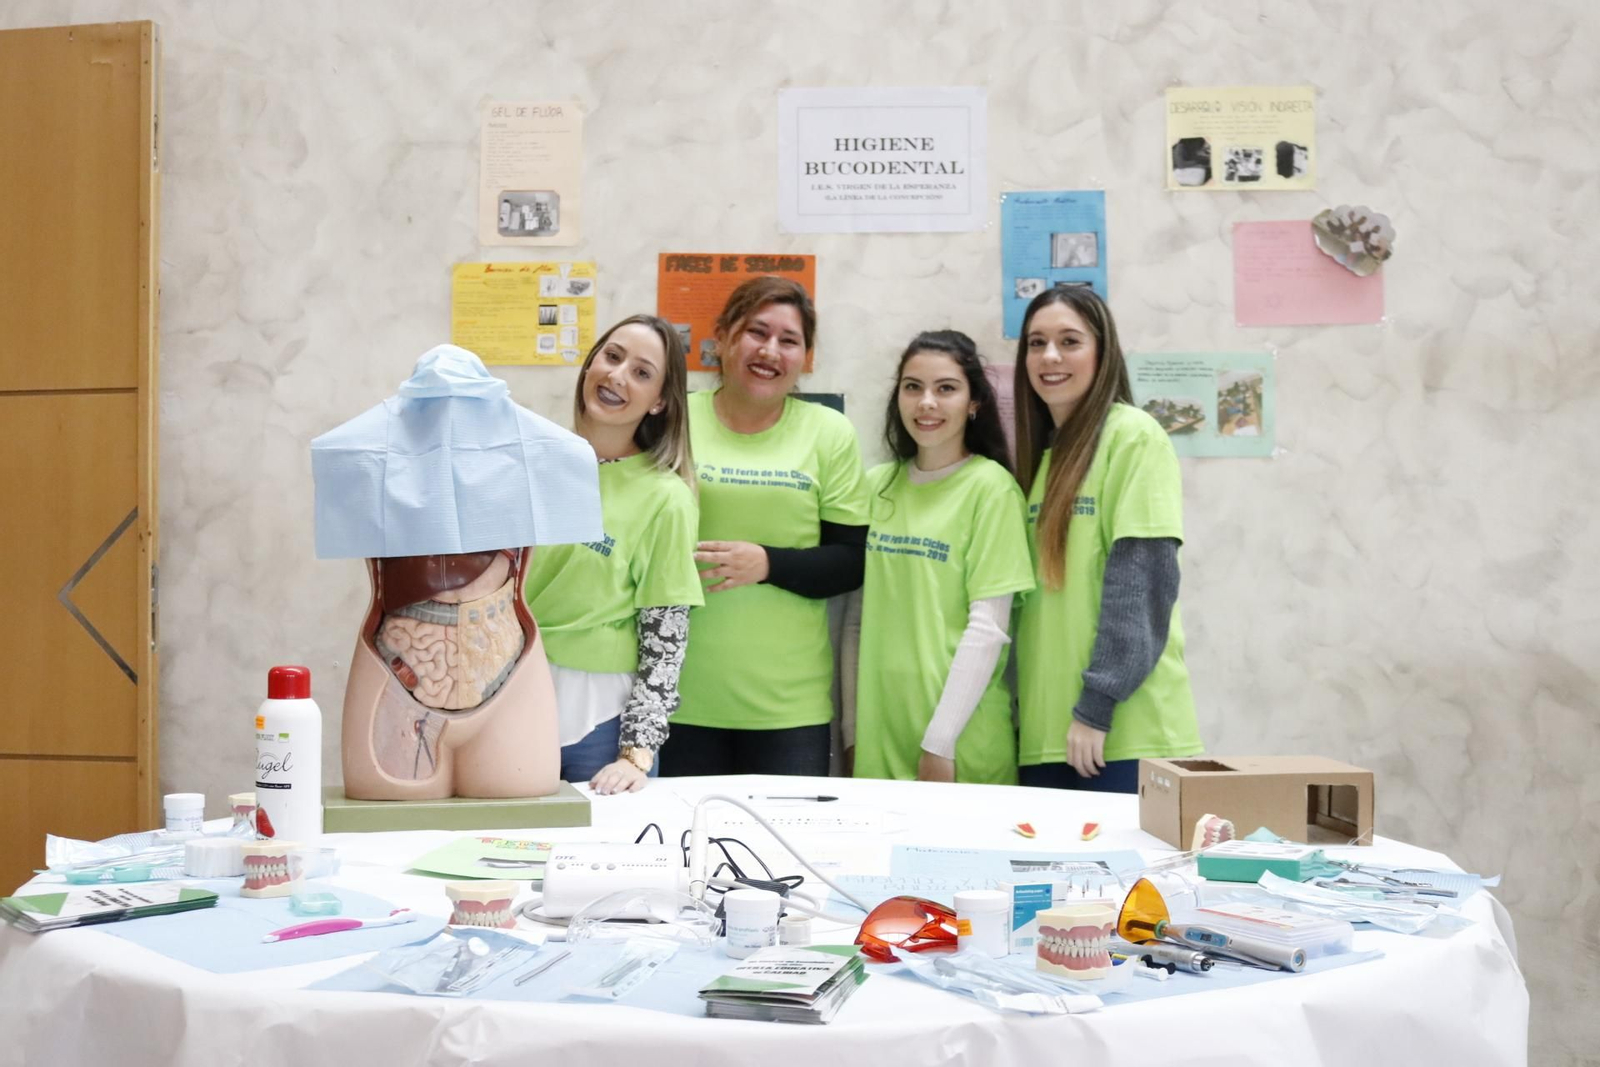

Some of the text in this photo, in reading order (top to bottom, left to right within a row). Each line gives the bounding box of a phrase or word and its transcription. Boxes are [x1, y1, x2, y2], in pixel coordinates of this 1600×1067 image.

[491, 106, 511, 118] GEL
[515, 106, 527, 118] DE
[834, 137, 935, 151] HIGIENE
[804, 160, 965, 176] BUCODENTAL
[836, 183, 872, 191] VIRGEN
[874, 183, 887, 191] DE
[889, 183, 900, 191] LA
[903, 183, 957, 191] ESPERANZA
[665, 255, 713, 273] FASES
[720, 256, 738, 273] DE
[721, 466, 734, 475] VII
[736, 468, 759, 477] Feria
[761, 469, 773, 478] de
[775, 469, 788, 478] los
[589, 541, 612, 557] 2019
[922, 537, 950, 552] Ciclos
[927, 549, 948, 562] 2019
